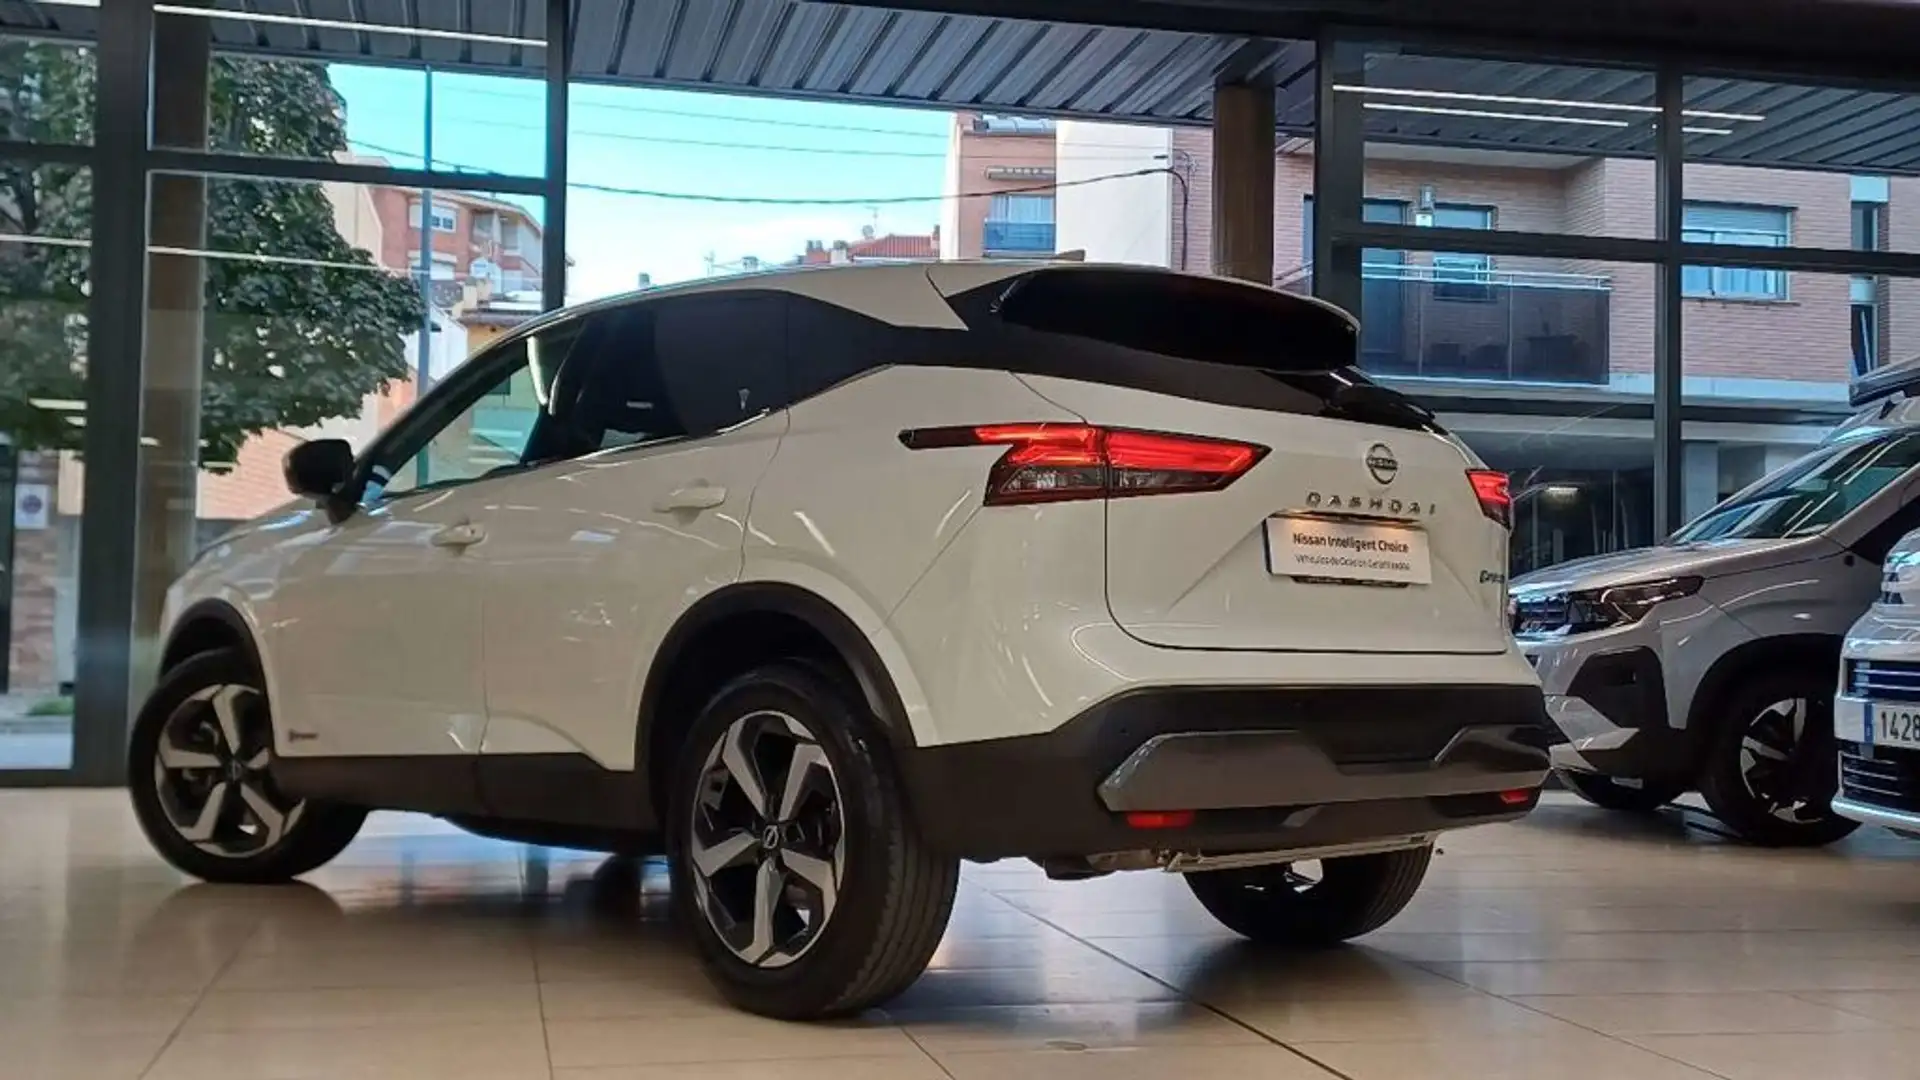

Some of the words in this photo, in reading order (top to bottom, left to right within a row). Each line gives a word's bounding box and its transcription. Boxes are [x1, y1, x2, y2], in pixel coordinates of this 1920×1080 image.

[1305, 491, 1436, 515] QASHQAI
[1293, 532, 1327, 546] Nissan
[1328, 535, 1376, 552] Intelligent
[1378, 540, 1409, 553] Choice
[1881, 711, 1920, 742] 1428
